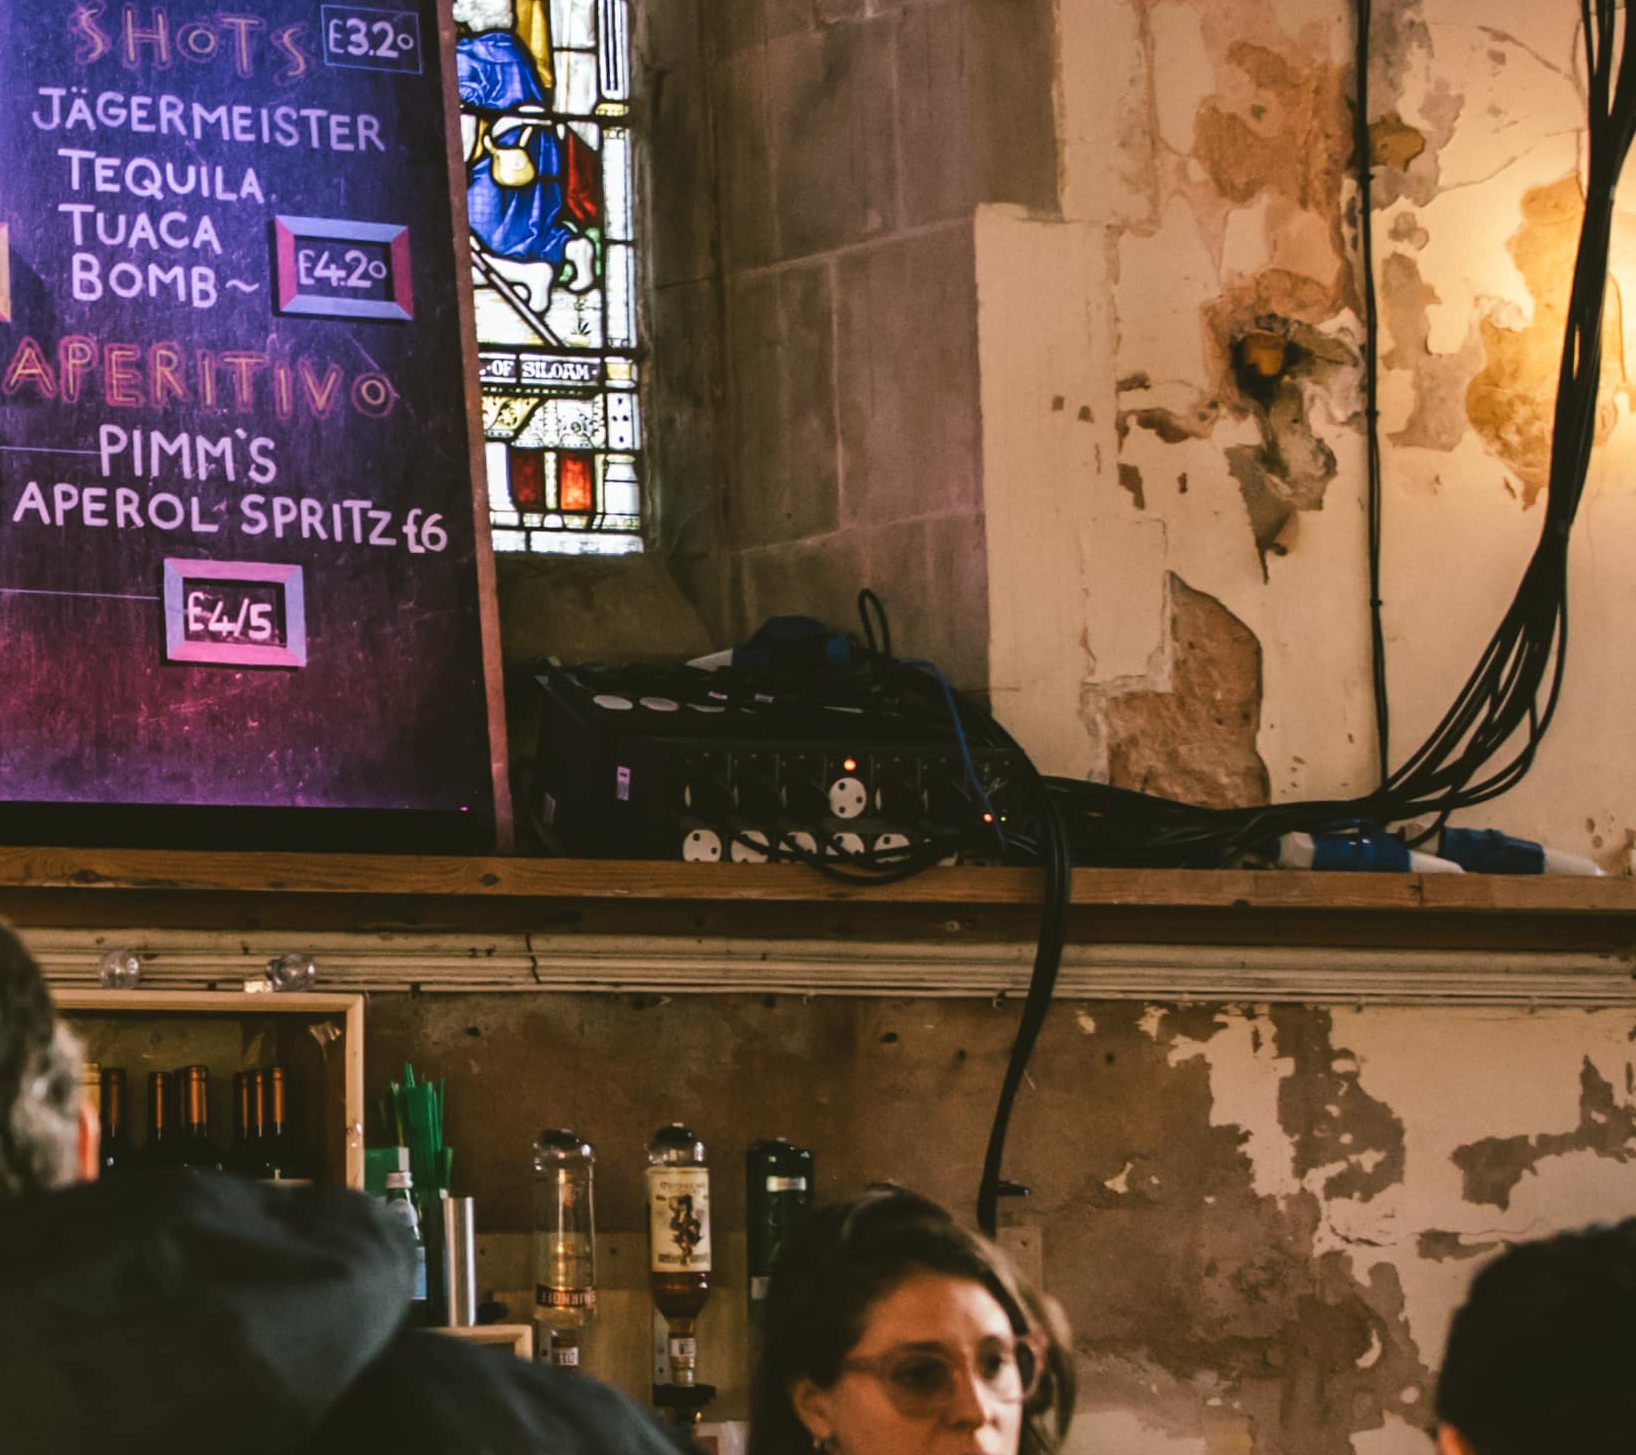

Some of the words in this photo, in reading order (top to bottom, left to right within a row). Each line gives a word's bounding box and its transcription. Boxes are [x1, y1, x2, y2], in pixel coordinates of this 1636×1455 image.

[30, 85, 387, 153] JÄGERMEISTER
[56, 147, 266, 205] TEQUILA
[56, 202, 223, 256] TUACA
[70, 252, 219, 310] BOMB
[1, 335, 400, 419] APERITIVO
[491, 359, 514, 377] OF
[521, 360, 590, 381] SILOAM
[97, 422, 279, 485] PIMM'S
[11, 480, 221, 534] APEROL
[239, 492, 398, 548] SPRITZ
[402, 507, 449, 555] £6
